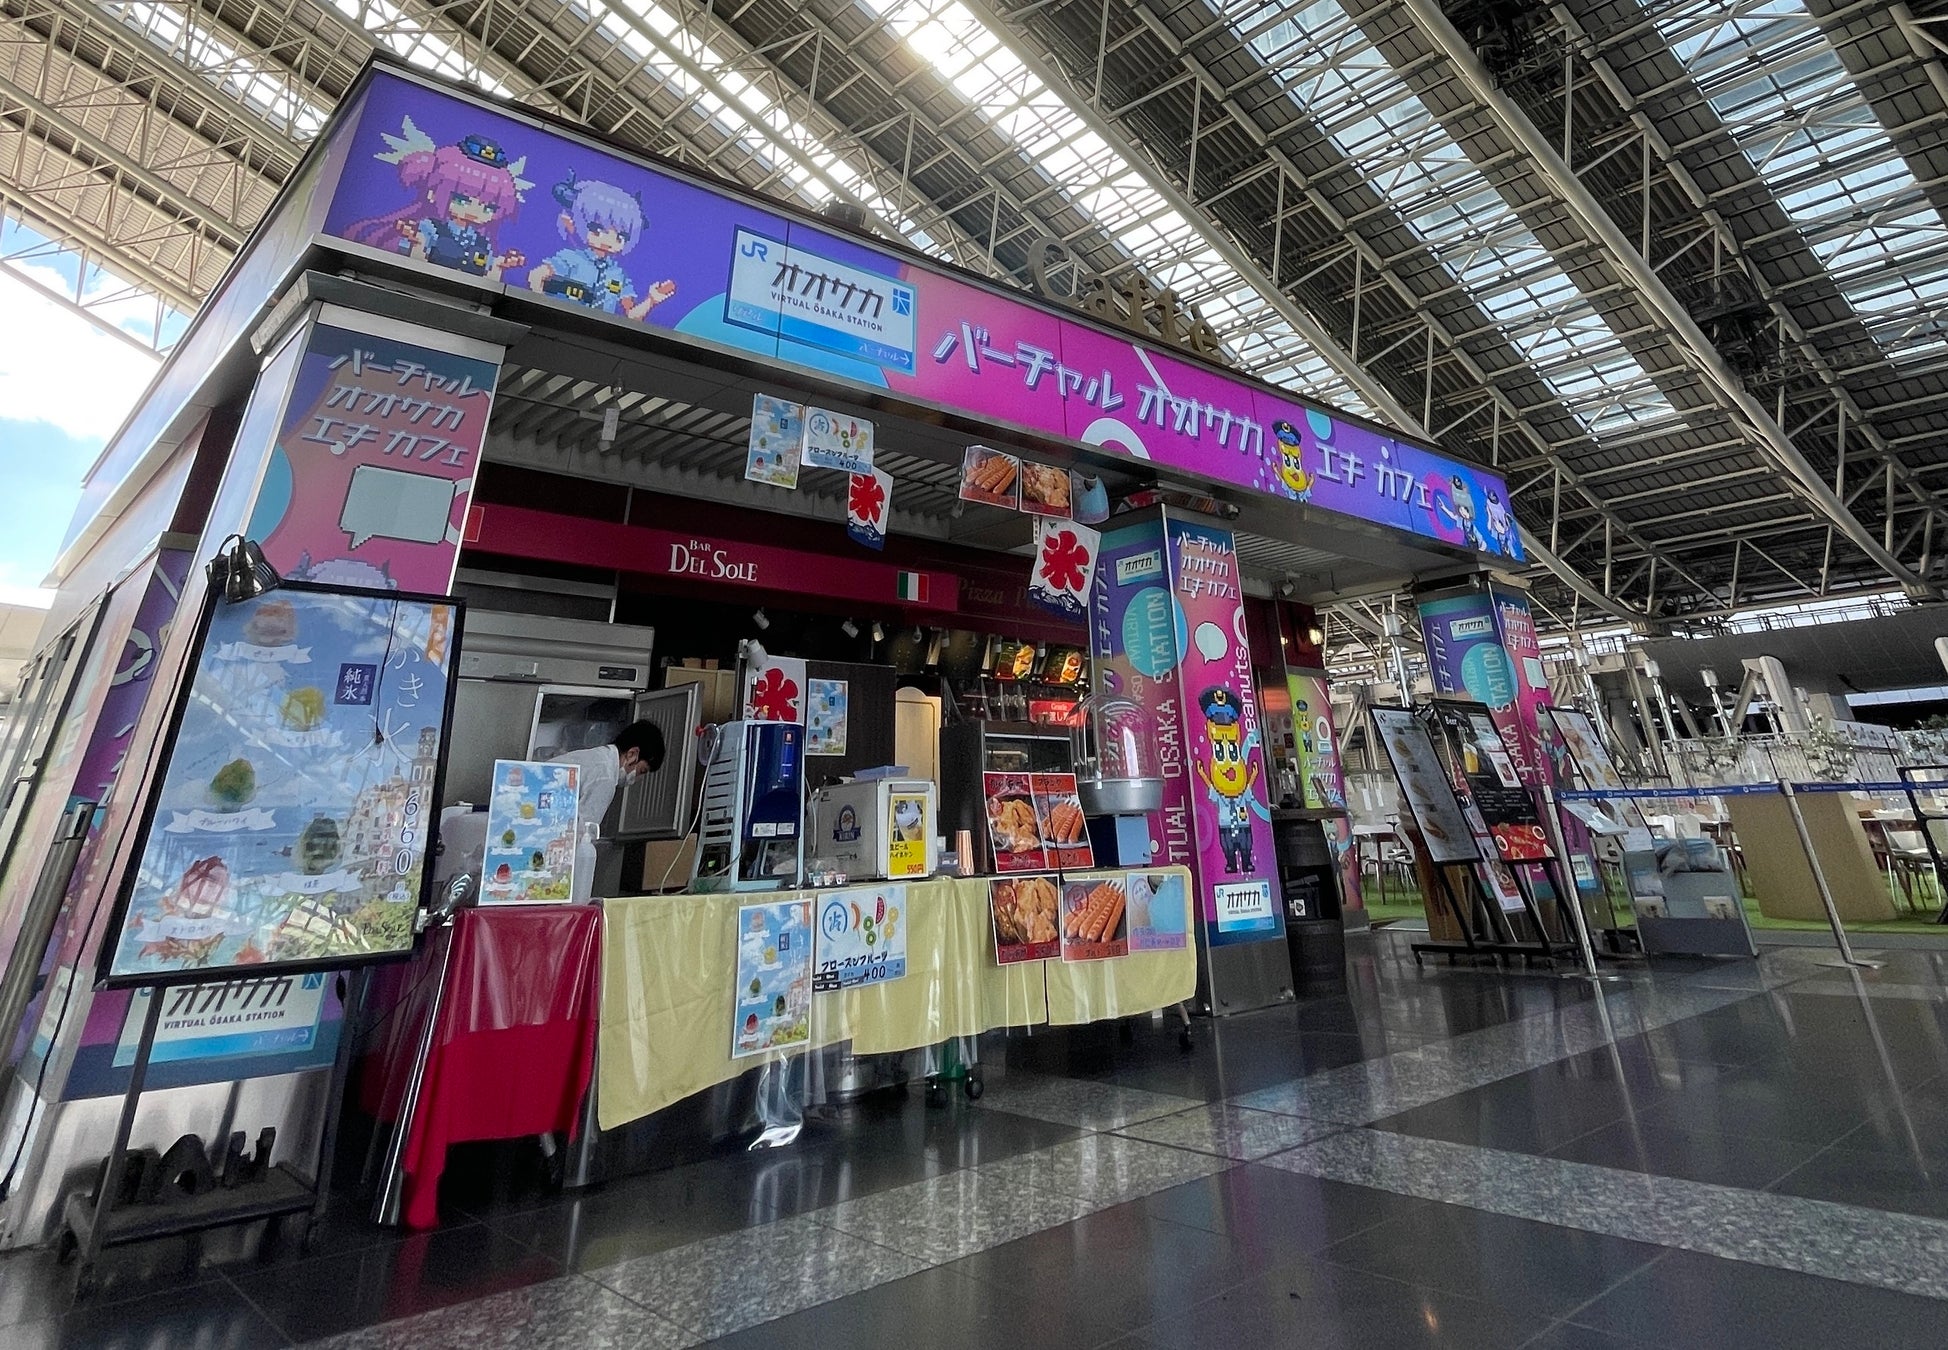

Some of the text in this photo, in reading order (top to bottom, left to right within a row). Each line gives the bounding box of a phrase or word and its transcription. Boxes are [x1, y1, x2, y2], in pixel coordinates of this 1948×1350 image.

[741, 241, 767, 262] JR
[771, 259, 884, 319] オオサカ
[771, 292, 810, 311] VIRTUAL
[847, 315, 883, 332] STATION
[328, 348, 480, 399] バーチャル
[326, 384, 466, 431] オオサカ
[932, 319, 1433, 510] バーチャル オオサカ エキ カフェ
[301, 415, 470, 469] エキ カフェ
[668, 543, 758, 582] DEL SOLE
[689, 540, 711, 552] BAR
[1176, 531, 1230, 557] バーチャル
[1207, 580, 1237, 600] カフェ
[340, 667, 363, 700] 純氷
[1145, 591, 1192, 867] TUAL OSAKA STATION
[395, 793, 419, 875] 660
[164, 1020, 205, 1031] VIRTUAL
[245, 1010, 285, 1022] STATION
